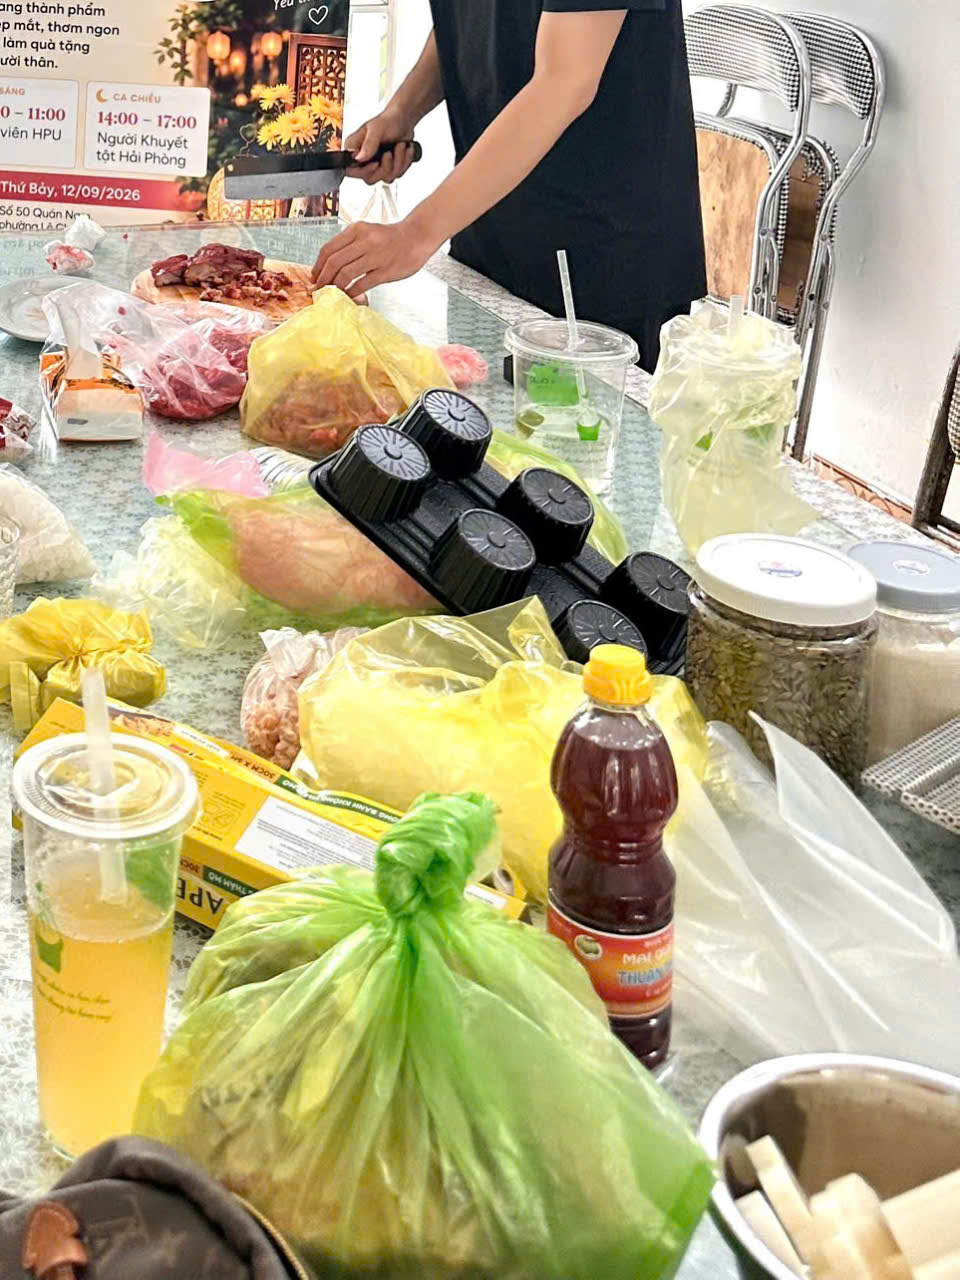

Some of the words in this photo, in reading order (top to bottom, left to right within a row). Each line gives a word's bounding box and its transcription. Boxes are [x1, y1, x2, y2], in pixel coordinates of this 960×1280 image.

[25, 0, 65, 15] thành
[67, 0, 106, 18] phẩm
[13, 18, 45, 34] mắt,
[47, 21, 83, 34] thơm
[86, 24, 120, 38] ngon
[2, 37, 27, 49] làm
[30, 36, 56, 53] quà
[59, 39, 91, 55] tặng
[24, 55, 58, 69] thân.
[113, 92, 128, 102] CA
[27, 107, 66, 121] 11:00
[97, 111, 139, 126] 14:00
[157, 114, 198, 130] 17:00
[1, 126, 28, 140] viên
[32, 128, 62, 141] HPU
[97, 131, 137, 148] Người
[141, 134, 188, 150] Khuyết
[96, 149, 116, 163] tật
[119, 149, 141, 164] Hải
[144, 152, 186, 168] Phòng
[0, 179, 25, 194] Thứ
[29, 181, 58, 199] Bảy,
[61, 183, 141, 202] 12/09/2026
[0, 205, 13, 216] Số
[16, 206, 30, 217] 50
[33, 207, 62, 219] Quán
